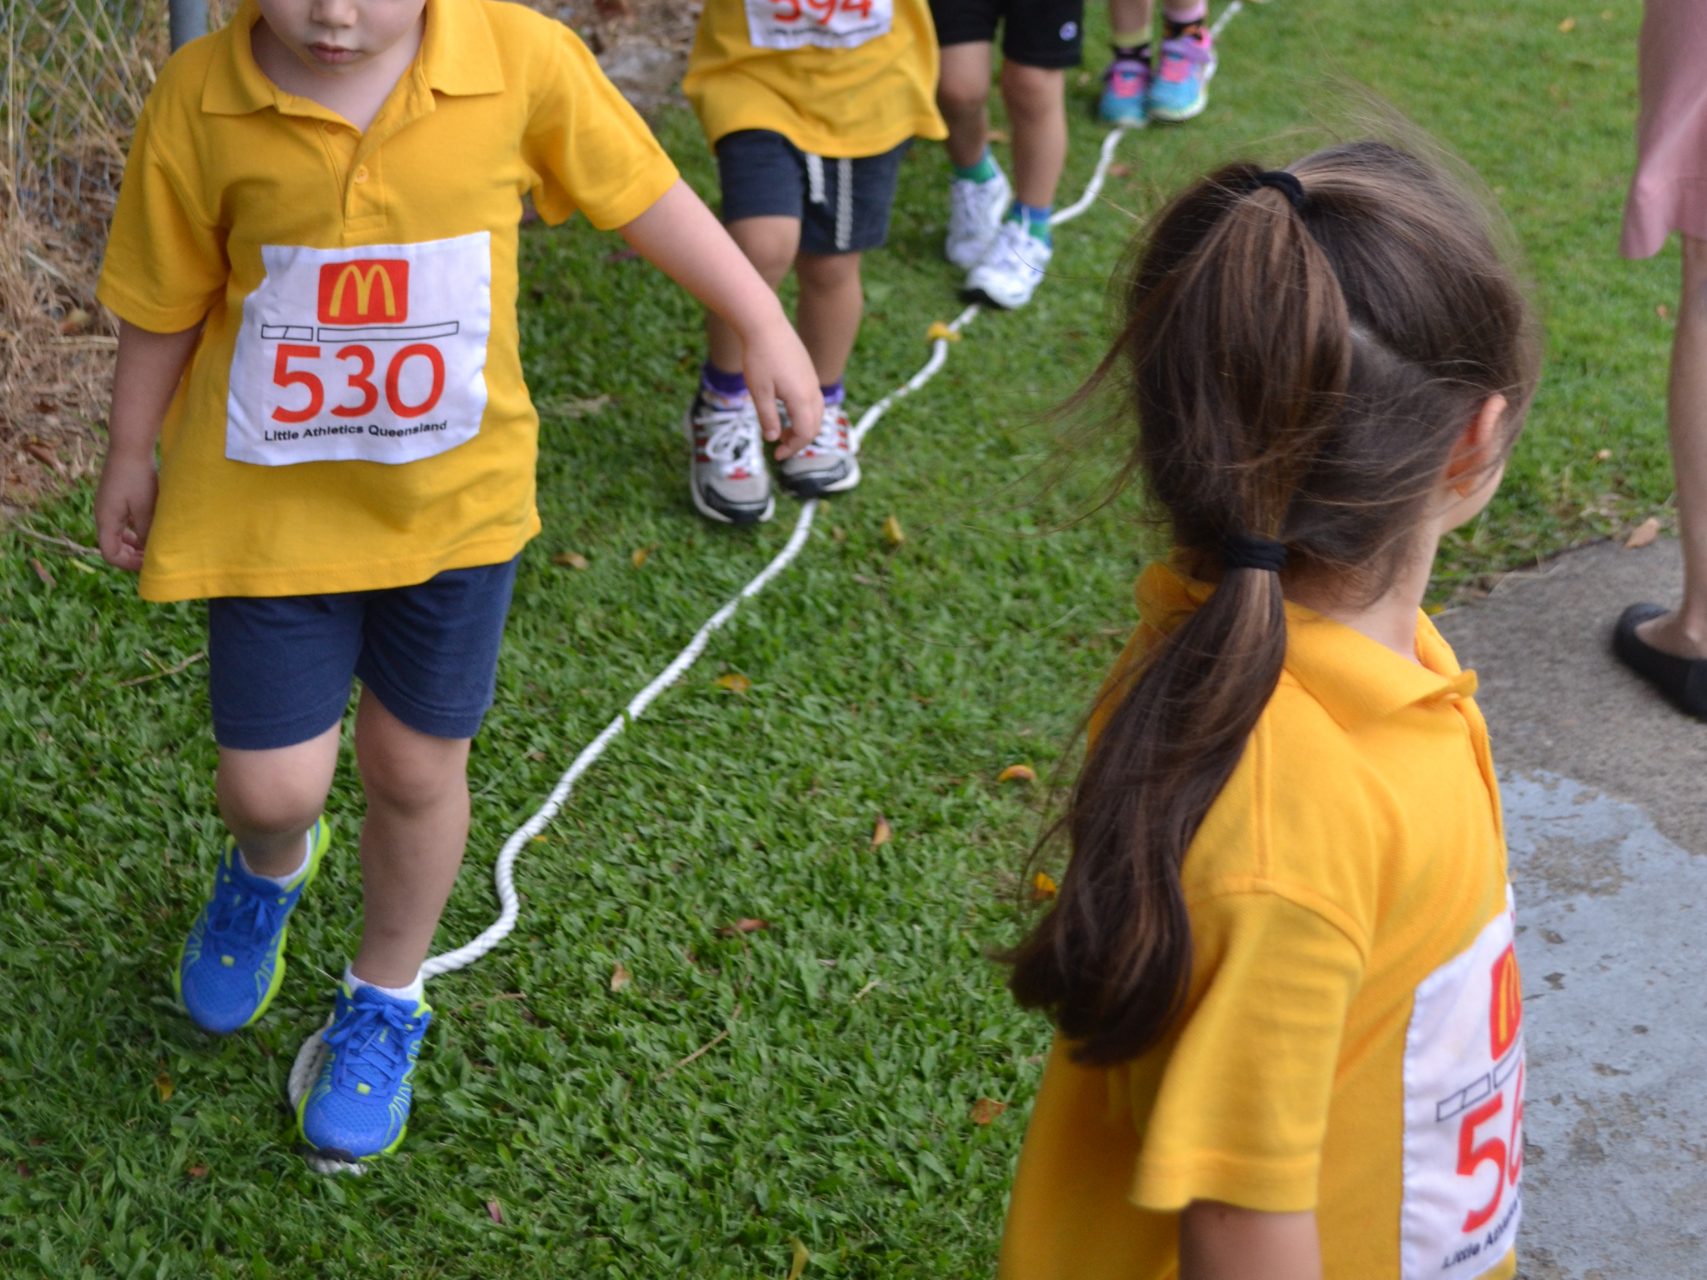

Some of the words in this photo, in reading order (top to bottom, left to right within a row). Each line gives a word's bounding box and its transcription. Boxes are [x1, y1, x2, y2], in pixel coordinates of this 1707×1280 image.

[271, 343, 446, 424] 530
[264, 429, 299, 442] Little
[303, 424, 364, 438] Athletics
[368, 420, 448, 438] Queensland
